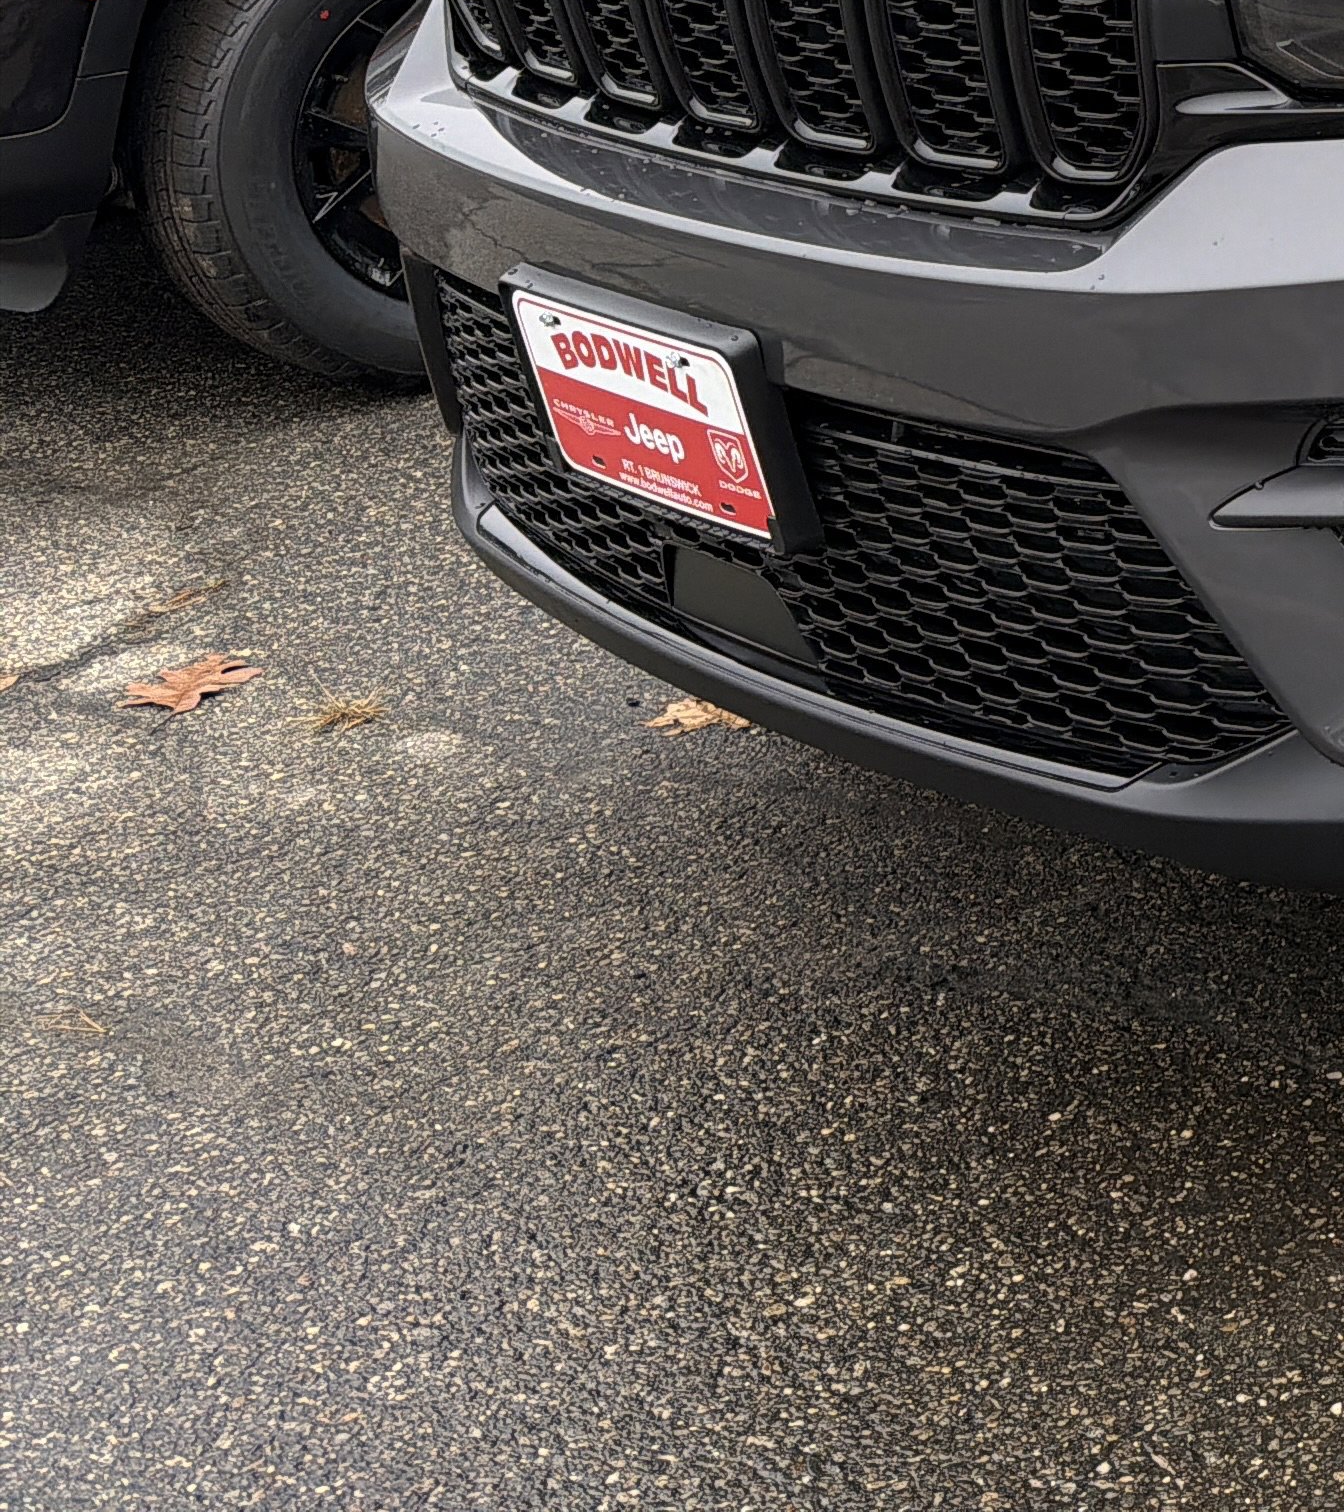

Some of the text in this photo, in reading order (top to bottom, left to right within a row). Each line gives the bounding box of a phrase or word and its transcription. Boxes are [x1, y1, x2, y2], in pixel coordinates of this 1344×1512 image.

[550, 330, 709, 417] BODWELL
[553, 398, 615, 428] CHRYSLER
[623, 412, 686, 464] Jeep
[718, 479, 762, 500] DODGE
